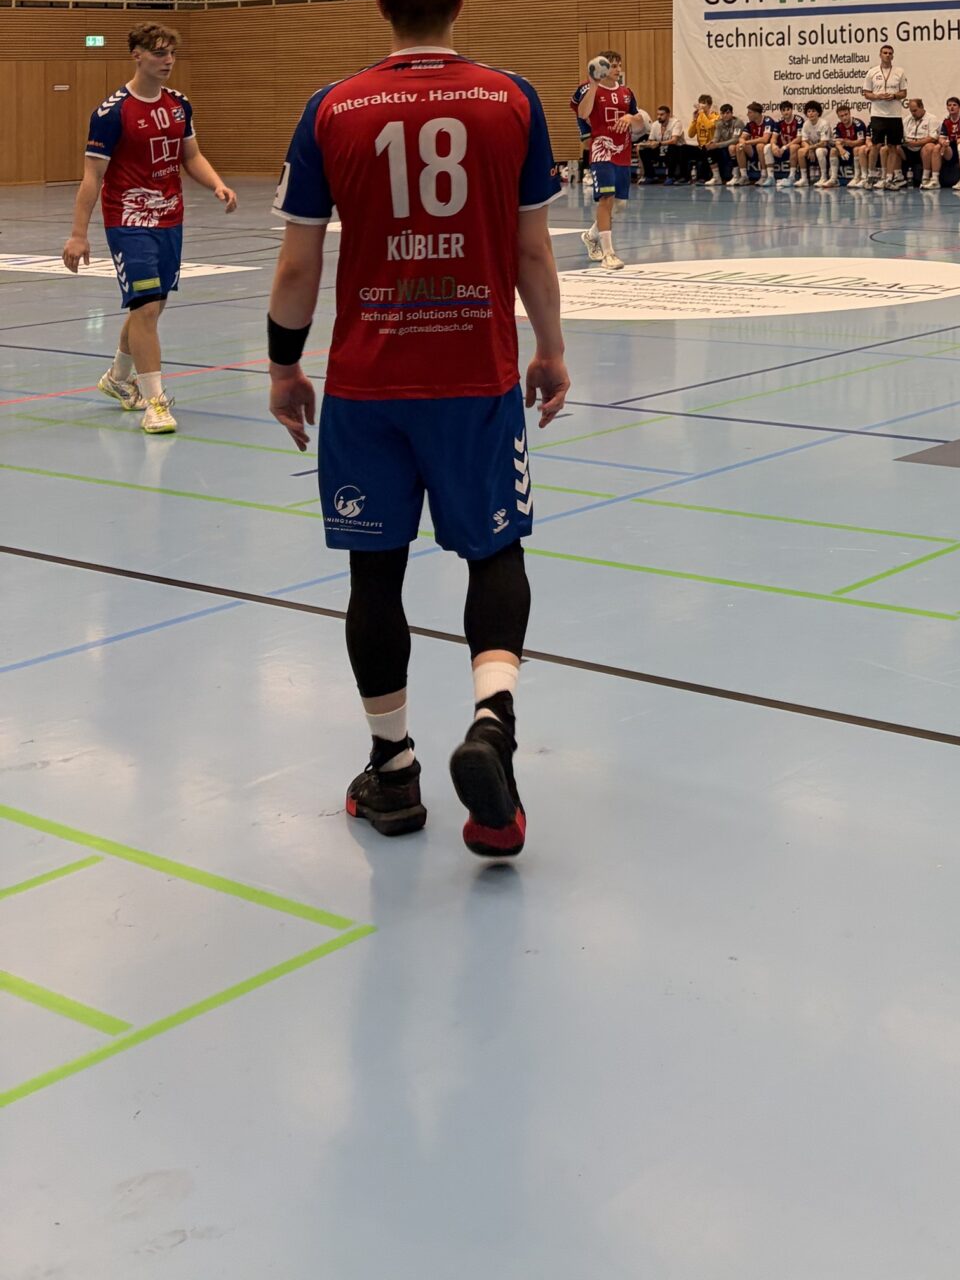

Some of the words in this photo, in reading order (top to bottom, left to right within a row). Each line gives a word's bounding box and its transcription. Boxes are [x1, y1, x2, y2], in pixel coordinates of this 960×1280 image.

[707, 24, 791, 48] technical
[797, 23, 888, 46] solutions
[896, 19, 960, 42] GmbH
[788, 54, 811, 65] Stahl-
[811, 54, 828, 64] und
[830, 52, 870, 64] Metallbau
[773, 70, 804, 81] Elektro-
[805, 70, 821, 80] und
[332, 91, 417, 115] interaktiv
[429, 86, 508, 103] Handball
[610, 92, 619, 105] 6
[150, 107, 170, 130] 10
[374, 117, 468, 218] 18
[387, 229, 465, 261] KÜBLER
[360, 310, 403, 321] technical
[406, 309, 458, 320] solutions
[325, 517, 383, 528] NINGSKONZEPTE
